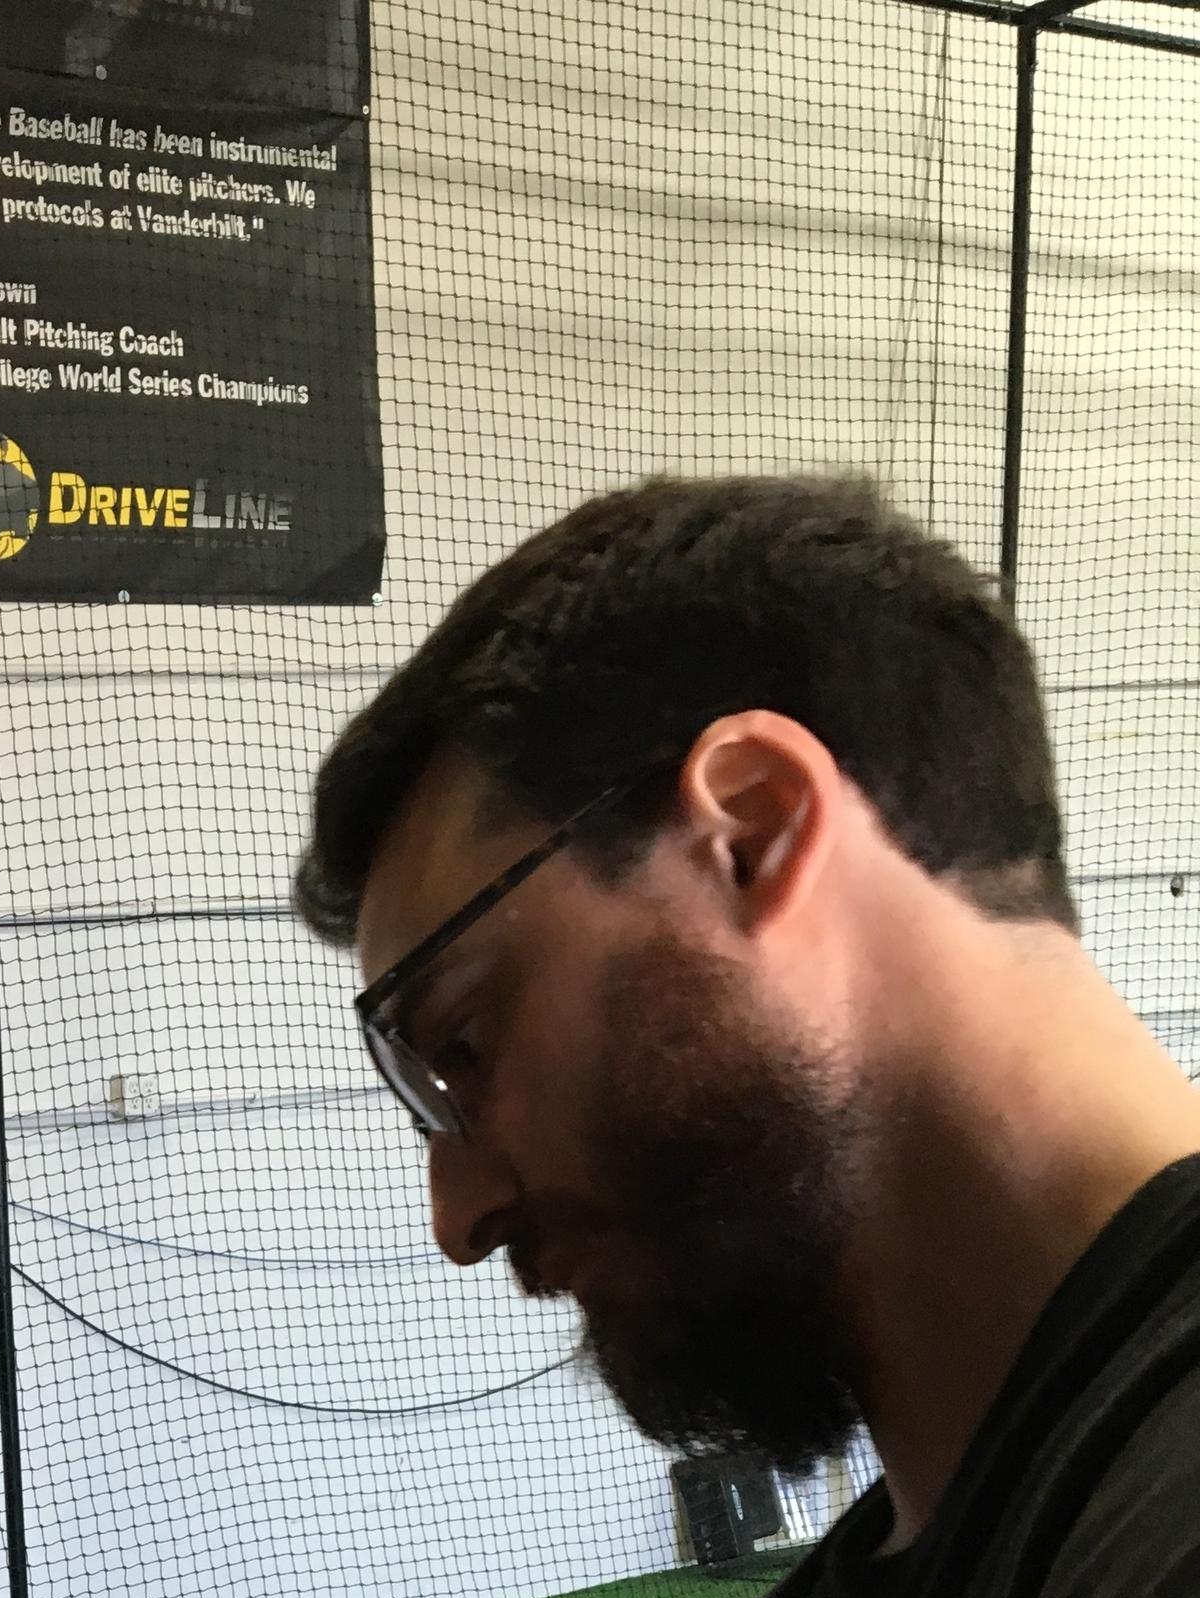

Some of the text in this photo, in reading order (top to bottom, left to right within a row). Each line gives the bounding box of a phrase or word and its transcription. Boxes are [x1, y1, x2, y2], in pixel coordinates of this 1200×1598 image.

[9, 106, 104, 146] Baseball
[109, 118, 148, 151] has
[153, 124, 203, 157] been
[210, 131, 337, 171] instrumental
[109, 163, 131, 191] of
[136, 166, 183, 197] elite
[189, 171, 281, 205] pitchers.
[285, 179, 316, 209] We
[2, 195, 104, 225] protocols
[110, 204, 133, 232] at
[136, 204, 264, 242] Vanderbilt."
[23, 317, 115, 357] Pitching
[119, 325, 184, 357] Coach
[58, 362, 121, 393] World
[128, 366, 193, 397] Series
[198, 371, 310, 407] Champions
